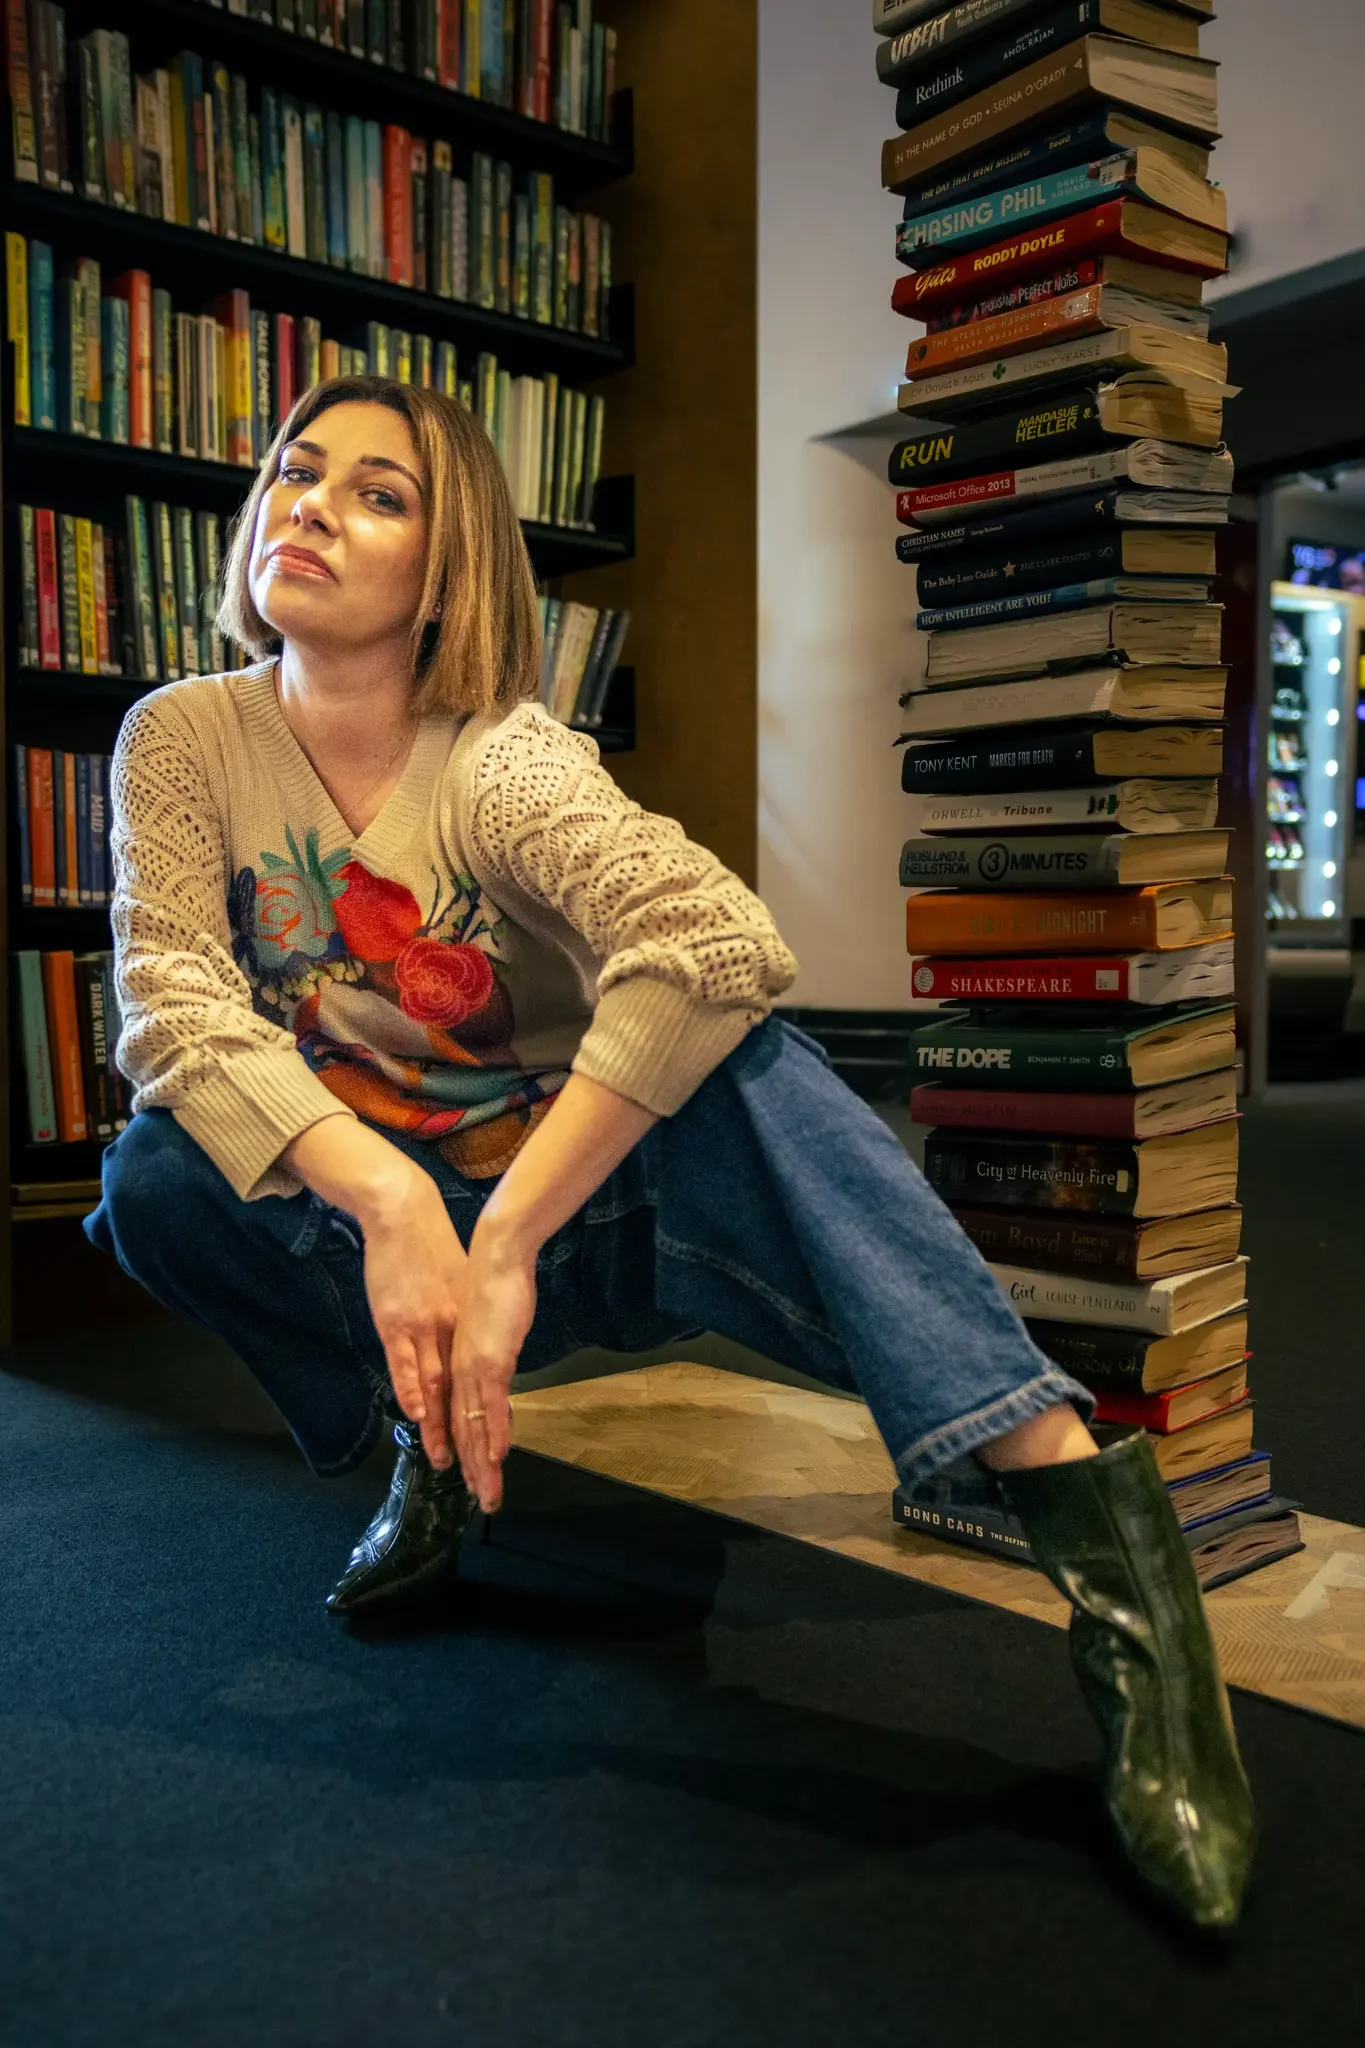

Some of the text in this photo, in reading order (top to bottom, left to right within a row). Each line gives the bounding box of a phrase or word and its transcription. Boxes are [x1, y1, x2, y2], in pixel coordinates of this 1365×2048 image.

[891, 11, 951, 65] UPBEAT
[1003, 27, 1055, 60] AMOL RAJAN
[915, 66, 964, 104] Rethink
[894, 66, 1067, 164] IN THE NAME OF GOD SELINA O'GRADY
[921, 147, 1031, 201] THE DAY THAT WENT MISSING
[900, 184, 1046, 249] CHASING PHIL
[973, 229, 1066, 272] RODDY DOYLE
[915, 267, 957, 300] Guts
[979, 293, 1016, 314] THOUSAND
[1018, 280, 1053, 304] PERFECT
[1054, 271, 1079, 292] NOTES
[932, 305, 1053, 349] THE ATLAS OF HAPPINESS
[954, 325, 1030, 353] HELEN RUSSELL
[1023, 357, 1056, 373] LUCKY
[1058, 349, 1094, 362] YEARS
[256, 357, 270, 416] BONES
[911, 386, 924, 396] Dr
[924, 379, 951, 395] David
[962, 372, 986, 386] Agus
[1015, 416, 1078, 443] HELLER
[1017, 404, 1080, 429] MANDASUE
[899, 435, 954, 470] RUN
[1071, 466, 1088, 475] GUIDE
[915, 478, 1011, 505] Microsoft Office 2013
[901, 527, 966, 548] CHRISTIAN NAMES
[922, 568, 999, 590] The Baby Loss Guide
[921, 592, 1051, 626] HOW INTELLIGENT ARE YOU?
[914, 755, 978, 774] TONY KENT
[988, 748, 1054, 769] MARKED FOR DEATH
[90, 793, 104, 833] MAID
[931, 808, 984, 821] ORWELL
[1003, 805, 1053, 817] Tribune
[906, 850, 966, 863] ROSLUND &
[988, 852, 1087, 873] 3 MINUTES
[1036, 909, 1107, 935] MIDNIGHT
[950, 978, 1072, 993] SHAKESPEARE
[89, 982, 104, 1019] DARK
[91, 1020, 107, 1065] WATER
[916, 1047, 1012, 1069] THE DOPE
[1027, 1055, 1061, 1064] BENJAMIN
[1068, 1056, 1091, 1065] SMITH
[976, 1161, 1004, 1182] City
[1006, 1164, 1017, 1180] of
[1020, 1165, 1085, 1188] Heavenly
[1088, 1168, 1116, 1185] Fire
[1008, 1225, 1061, 1258] Boyd
[1071, 1230, 1110, 1249] Love is
[1010, 1281, 1037, 1303] Girl
[1046, 1290, 1137, 1313] LOUISE PENTLAND
[903, 1504, 985, 1538] BOND CARS
[990, 1532, 1003, 1541] THE
